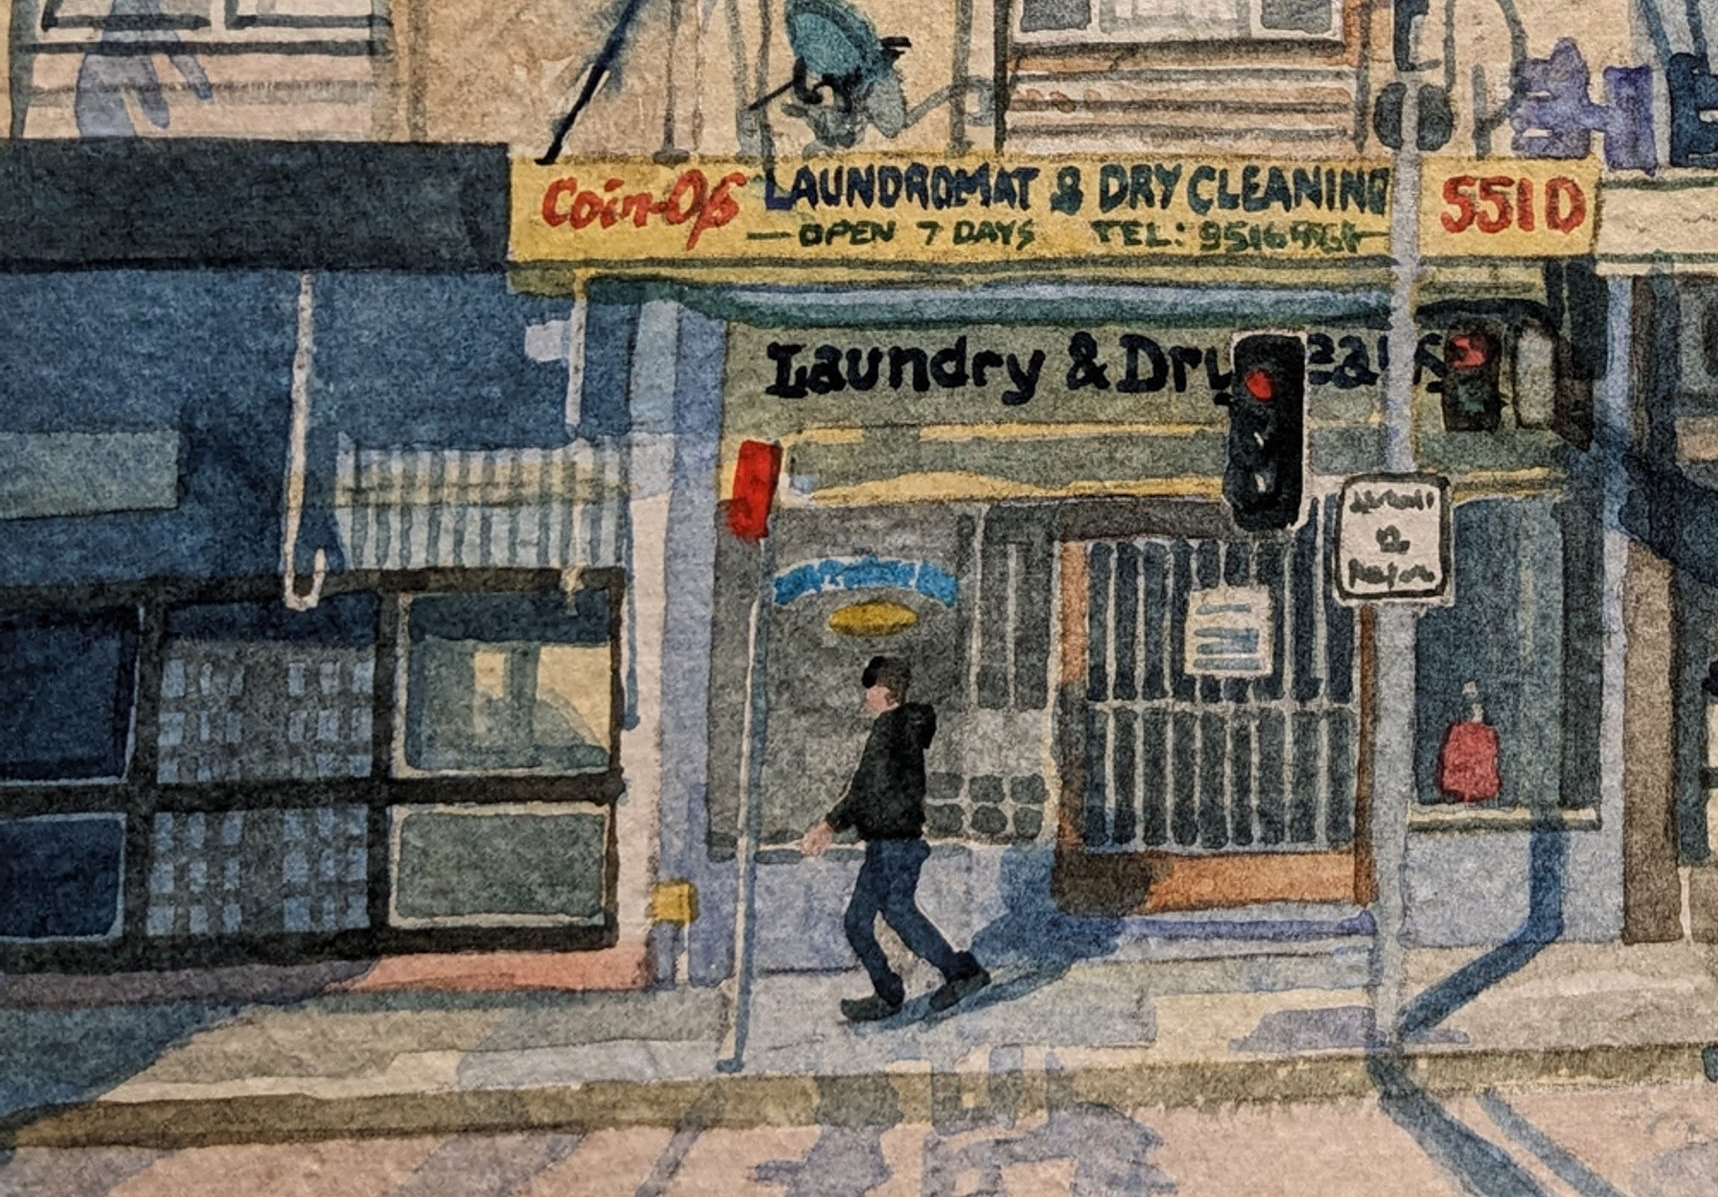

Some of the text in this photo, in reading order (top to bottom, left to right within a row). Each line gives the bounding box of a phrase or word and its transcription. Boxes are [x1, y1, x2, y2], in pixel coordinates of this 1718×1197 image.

[763, 162, 1040, 212] LAUNDROMAT
[1099, 162, 1182, 213] DRY
[798, 220, 896, 247] OPEN
[919, 221, 941, 245] 7
[952, 218, 1036, 250] DAYS
[764, 335, 1046, 406] Laundry
[1066, 331, 1111, 392] &
